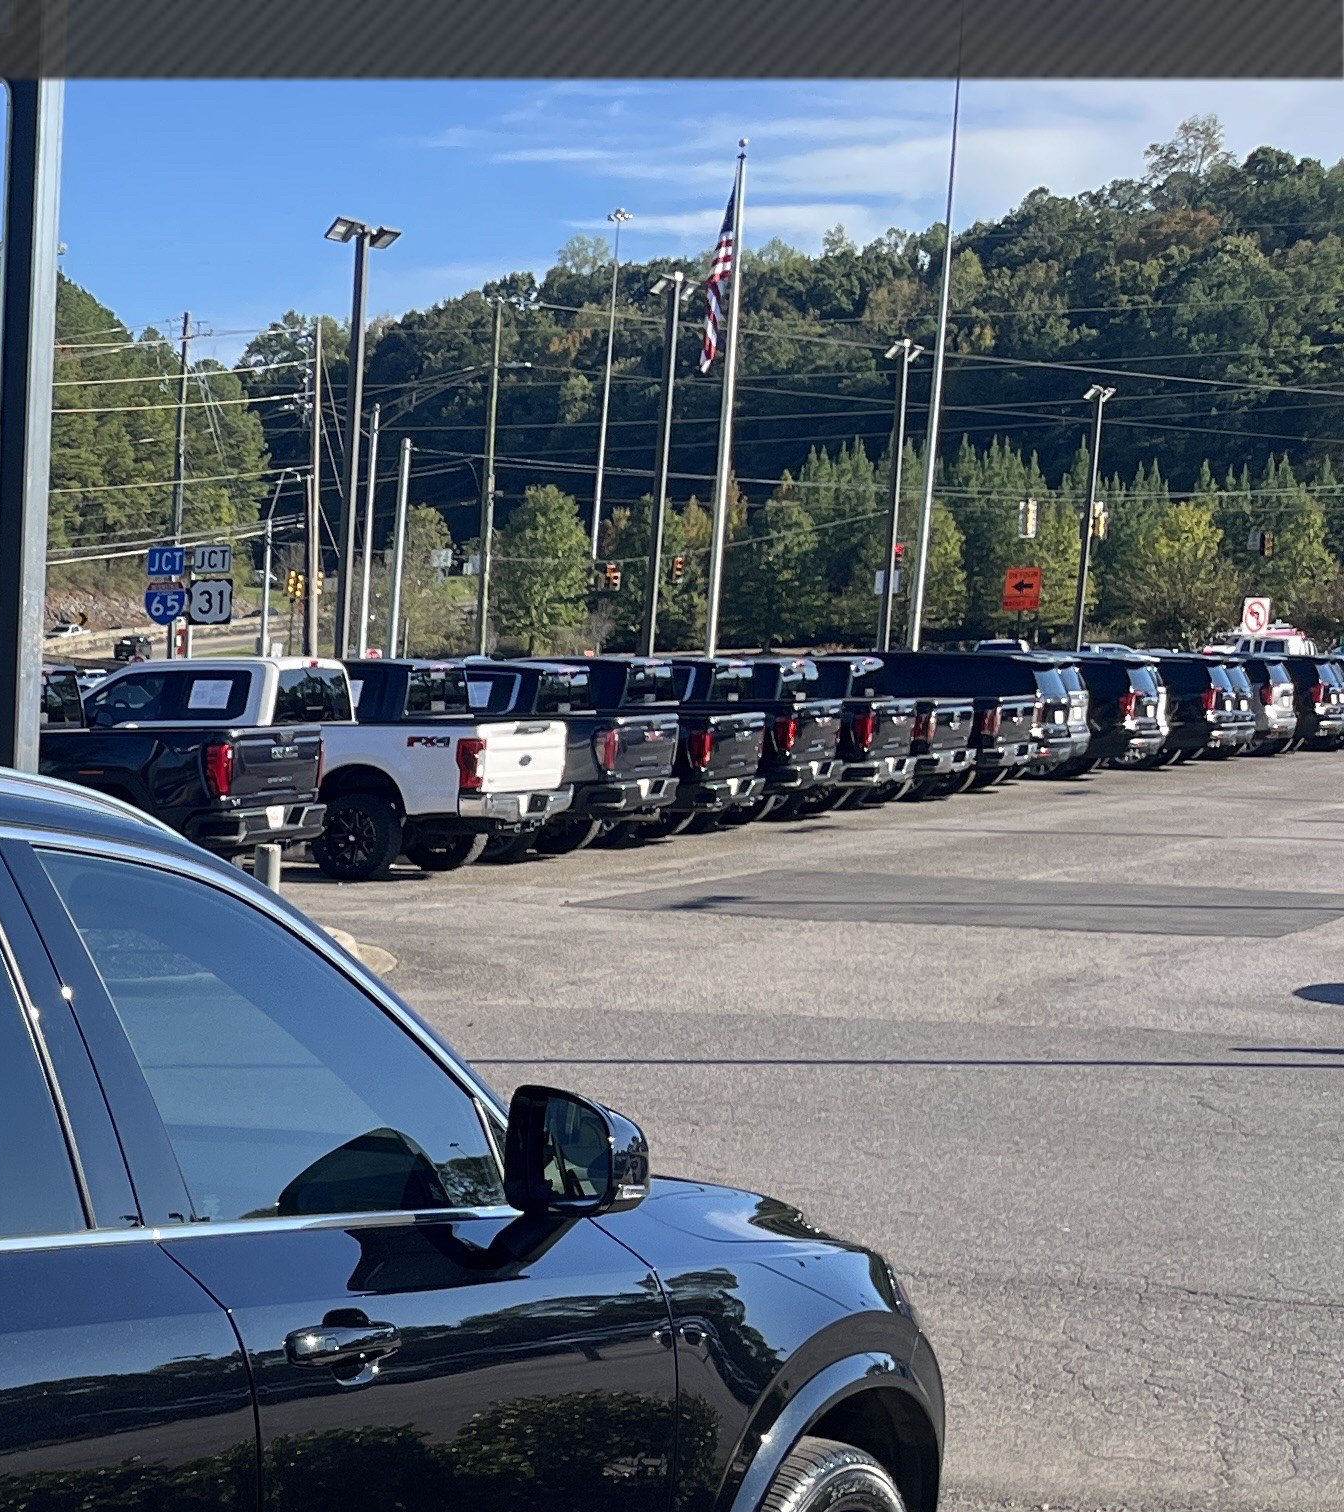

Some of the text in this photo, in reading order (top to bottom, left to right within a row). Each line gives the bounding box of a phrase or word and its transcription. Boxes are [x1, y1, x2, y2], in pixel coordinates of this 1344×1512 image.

[150, 552, 182, 572] JCT
[196, 550, 228, 569] JCT
[151, 595, 180, 616] 65
[198, 590, 224, 615] 31
[407, 736, 451, 748] FX4
